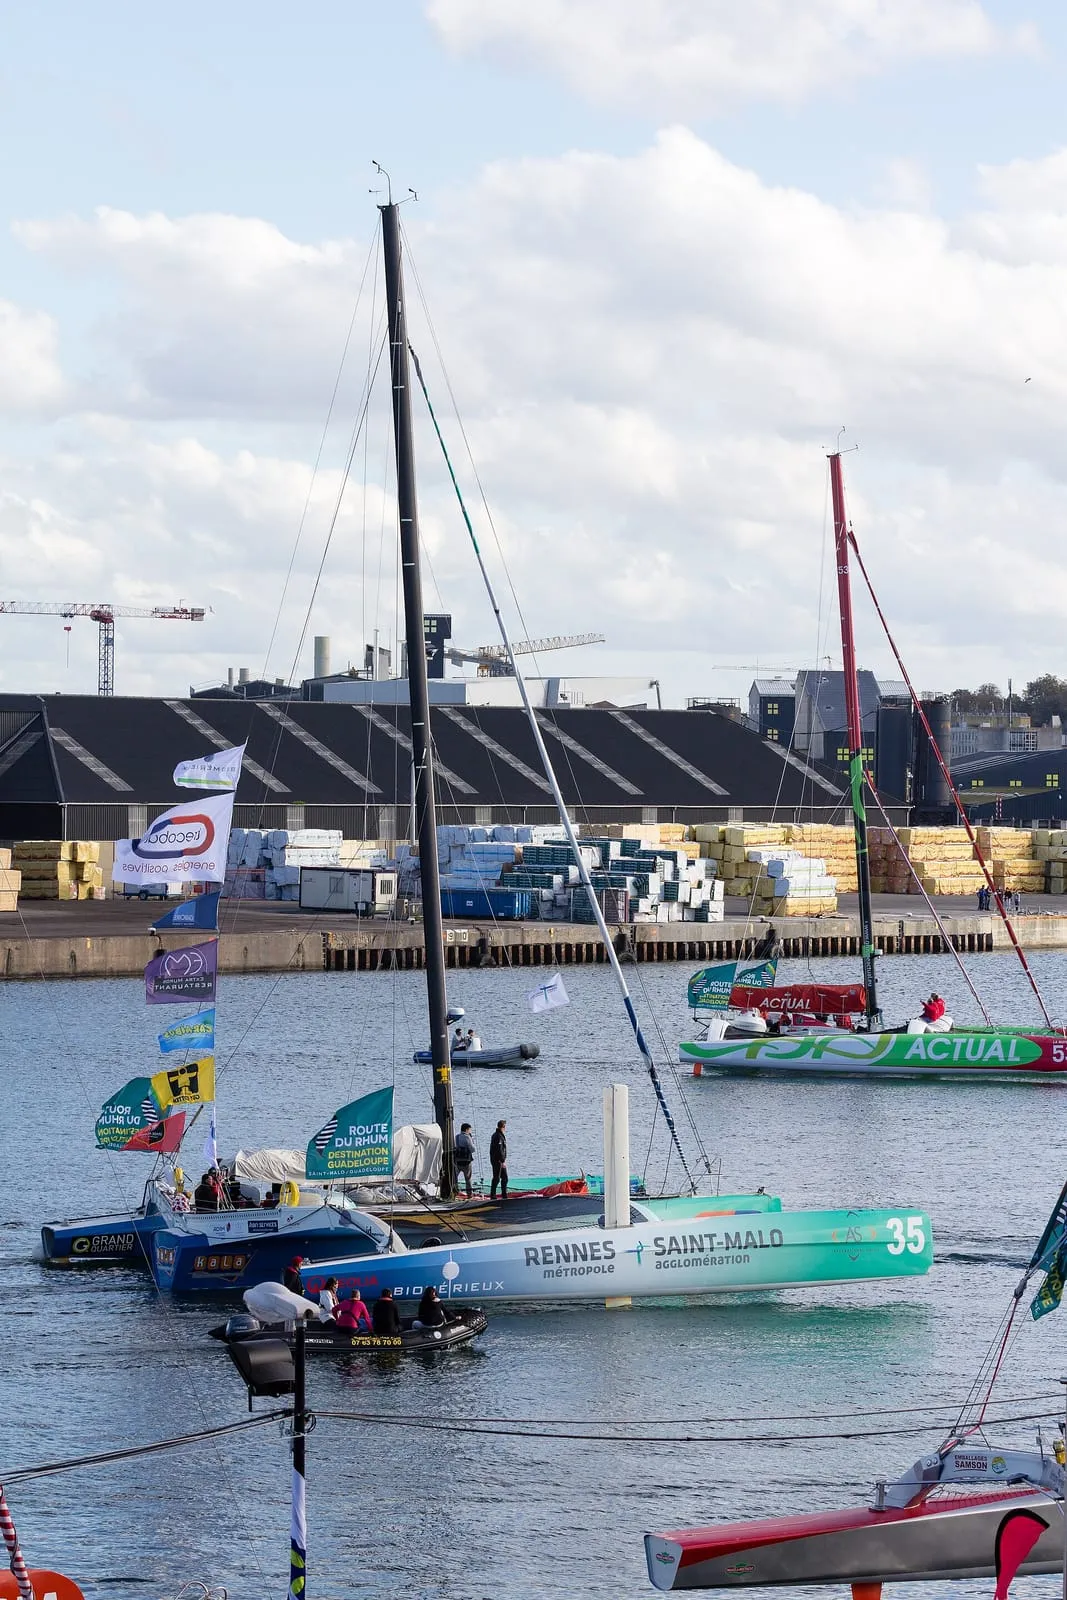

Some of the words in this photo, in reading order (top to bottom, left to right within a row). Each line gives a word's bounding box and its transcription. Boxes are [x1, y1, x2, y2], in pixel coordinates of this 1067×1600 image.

[838, 565, 849, 575] 53
[760, 997, 811, 1010] ACTUAL
[904, 1037, 1021, 1062] ACTUAL
[1052, 1044, 1067, 1063] 5
[349, 1123, 389, 1136] ROUTE
[335, 1137, 353, 1147] DU
[355, 1134, 389, 1147] RHUM
[328, 1147, 389, 1159] DESTINATION
[327, 1157, 389, 1169] GUADELOUPE
[92, 1233, 135, 1246] GRAND
[886, 1216, 925, 1255] 35
[91, 1243, 133, 1253] QUARTIER
[524, 1240, 616, 1266] RENNES
[654, 1228, 784, 1256] SAINT-MALO
[338, 1275, 379, 1288] EOLIA
[393, 1281, 505, 1296] BIOÉRIEUX
[954, 1460, 988, 1470] SAMSON
